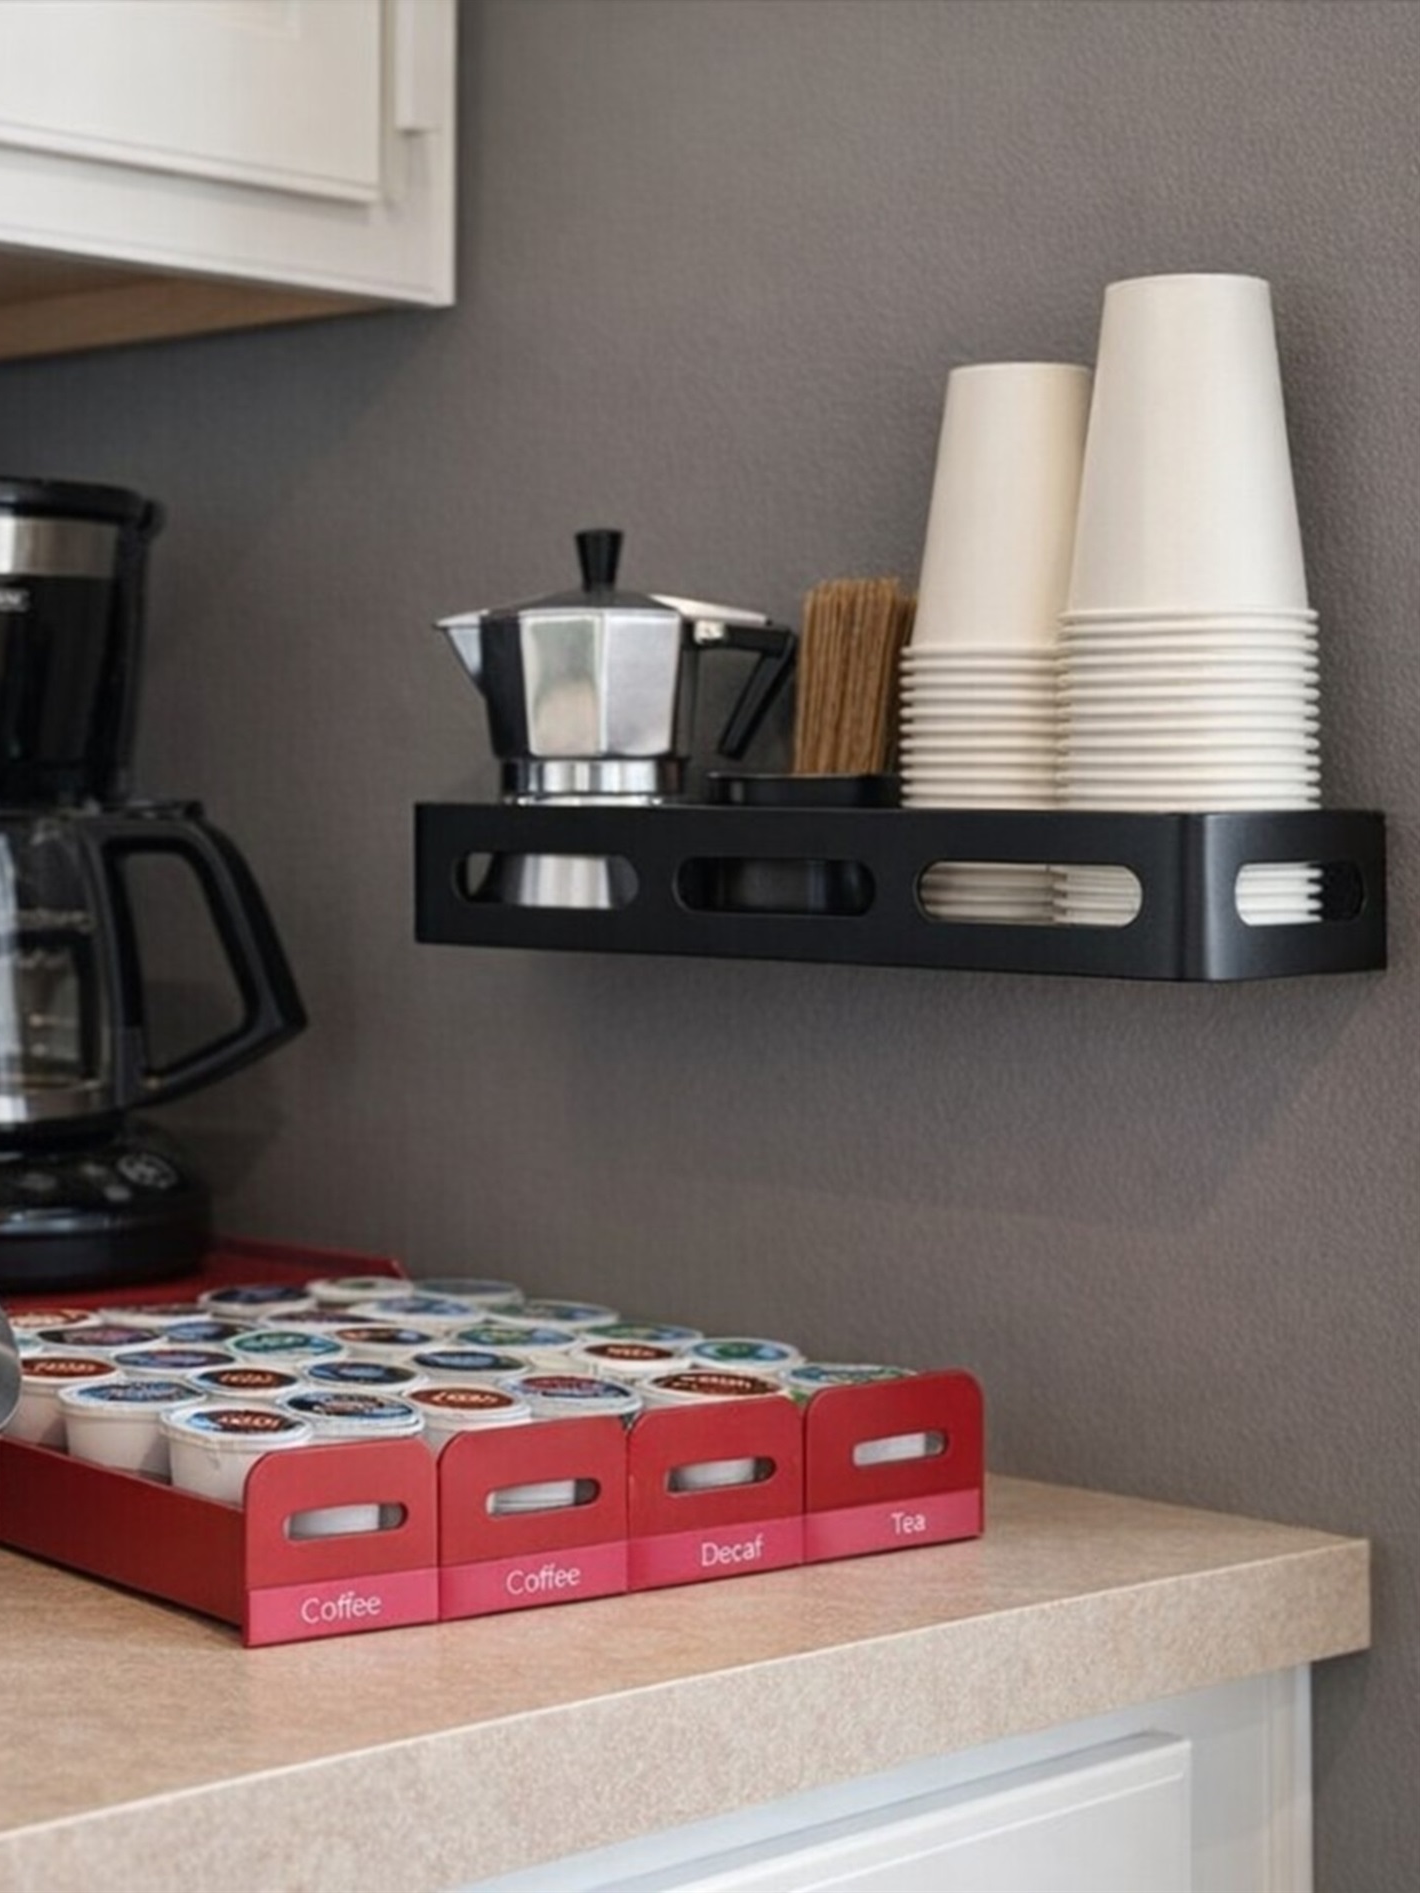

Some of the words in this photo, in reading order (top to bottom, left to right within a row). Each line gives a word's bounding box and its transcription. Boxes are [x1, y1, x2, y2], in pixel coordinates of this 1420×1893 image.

[891, 1511, 926, 1535] Tea
[700, 1533, 764, 1567] Decaf
[506, 1563, 580, 1595] Coffee
[300, 1591, 382, 1624] Coffee
